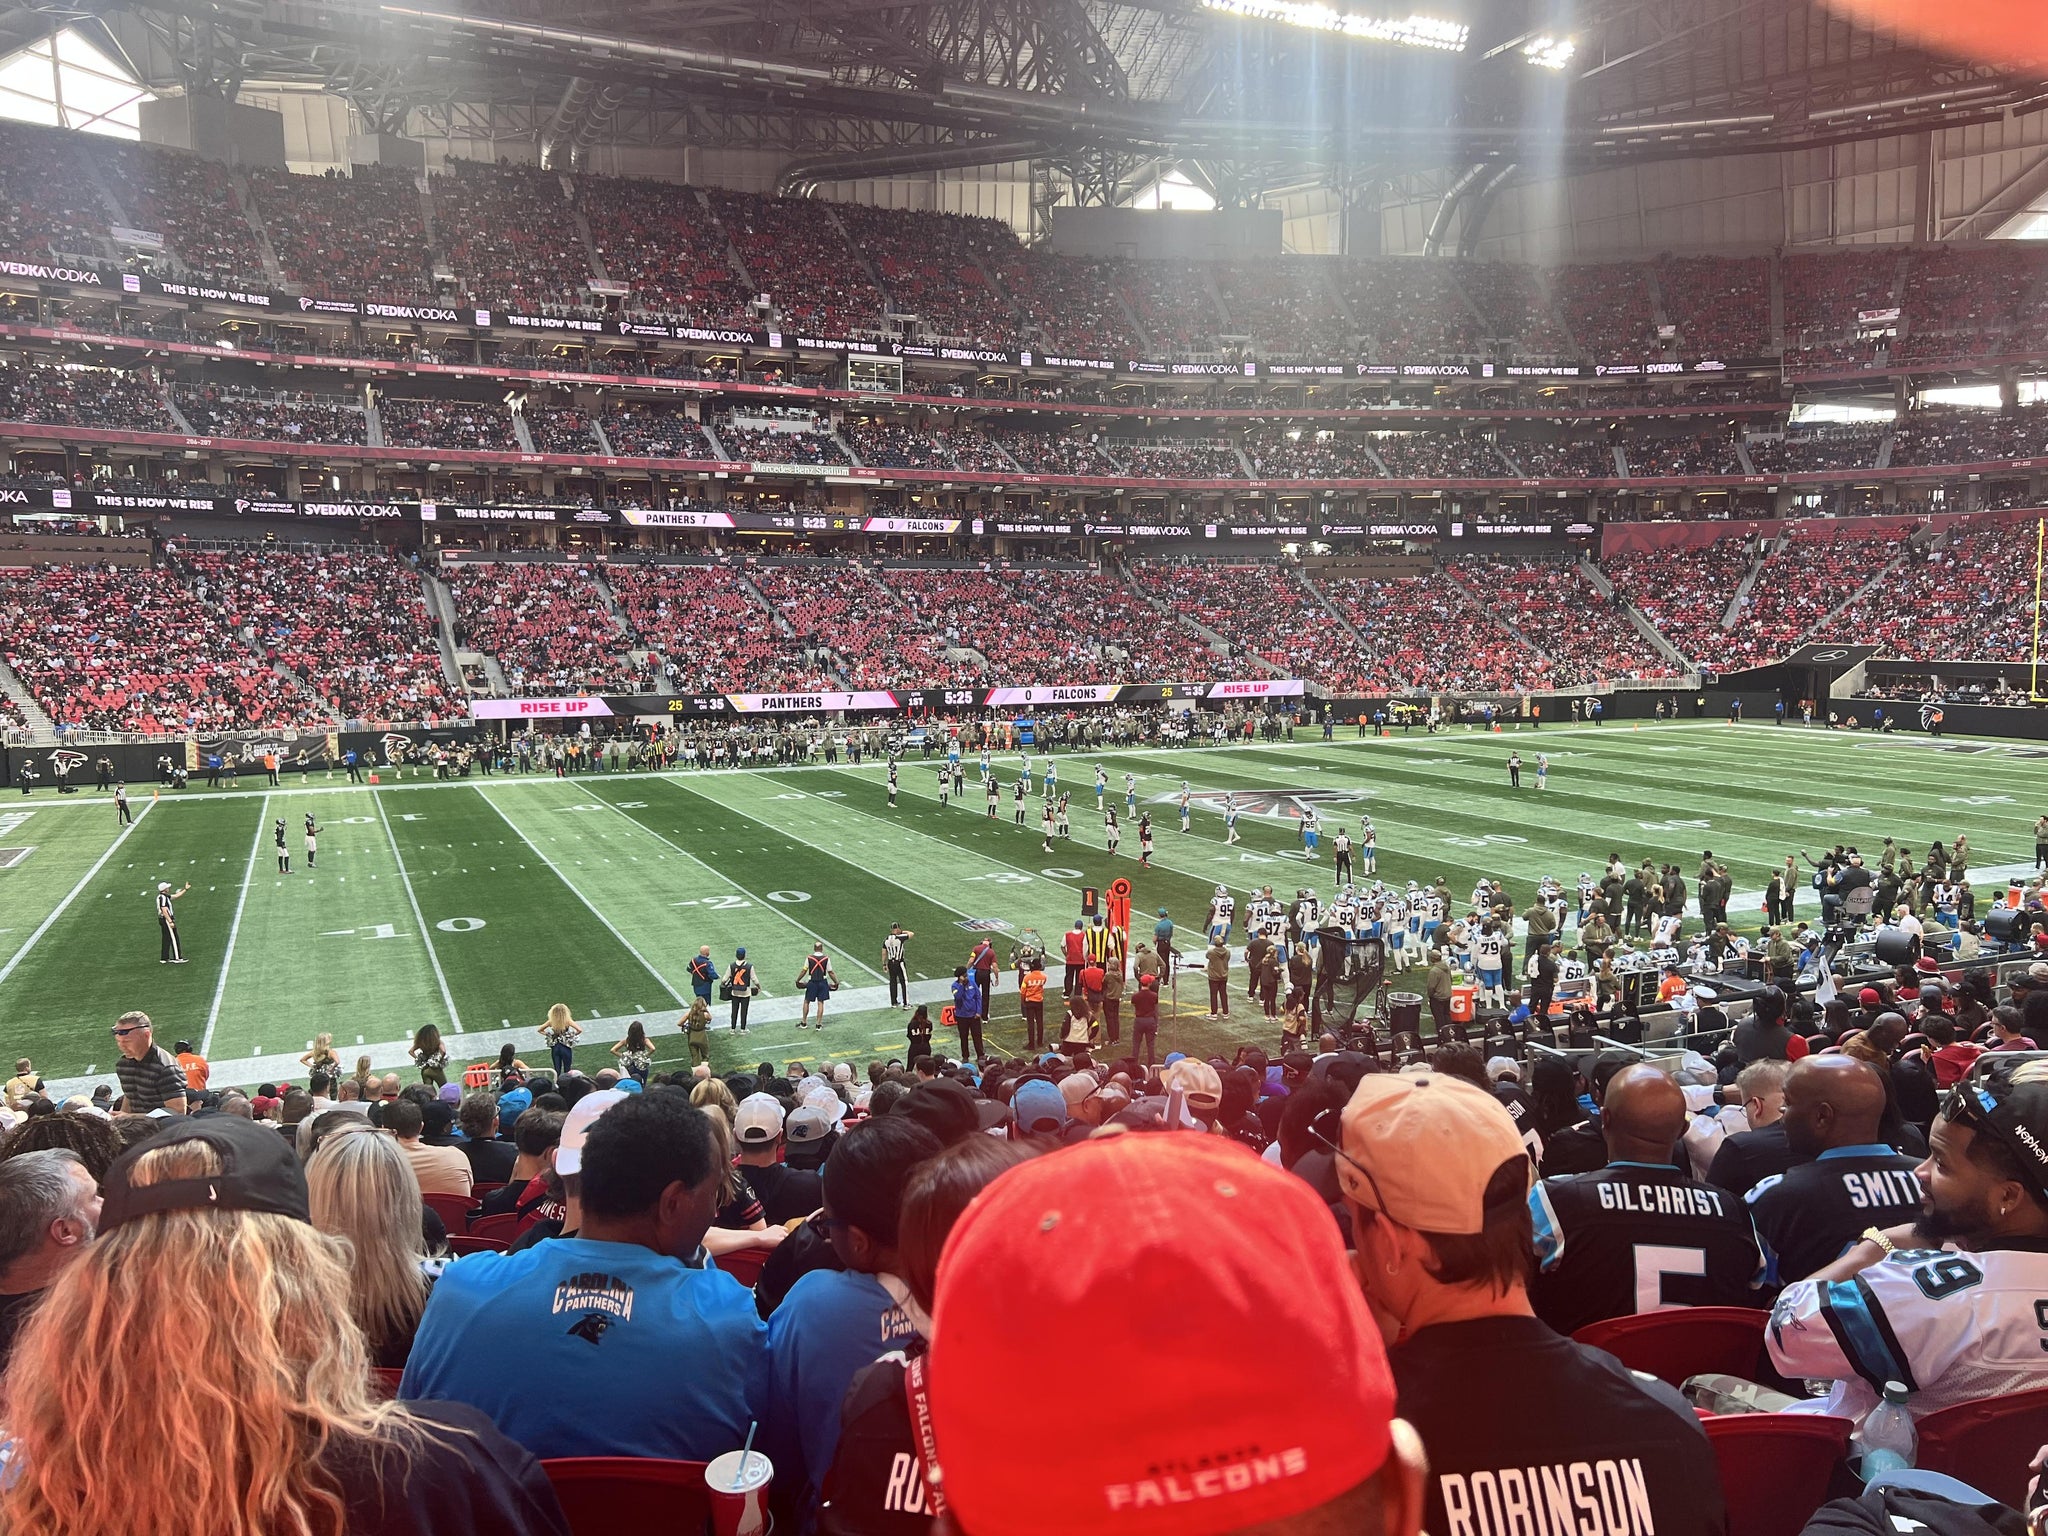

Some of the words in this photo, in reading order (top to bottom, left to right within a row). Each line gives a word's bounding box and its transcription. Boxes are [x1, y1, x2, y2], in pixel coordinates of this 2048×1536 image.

[161, 283, 187, 295] THIS
[188, 286, 199, 296] IS
[200, 288, 227, 300] HOW
[228, 291, 247, 303] WE
[247, 294, 270, 306] RISE
[507, 315, 530, 326] THIS
[530, 317, 540, 326] IS
[540, 318, 565, 328] HOW
[565, 320, 581, 330] WE
[582, 321, 603, 331] RISE
[796, 338, 815, 347] THIS
[816, 339, 824, 348] IS
[825, 340, 846, 349] HOW
[846, 342, 860, 351] WE
[860, 343, 878, 352] RISE
[1044, 357, 1061, 365] THIS
[1061, 358, 1068, 366] IS
[1069, 359, 1087, 367] HOW
[1087, 360, 1099, 368] WE
[1099, 361, 1114, 369] RISE
[1646, 363, 1683, 374] SVEDKA
[1286, 366, 1294, 374] IS
[1295, 366, 1314, 374] HOW
[1314, 366, 1326, 374] WE
[1327, 366, 1343, 374] RISE
[1506, 367, 1523, 375] THIS
[1523, 367, 1531, 375] IS
[1531, 367, 1550, 375] HOW
[1550, 367, 1563, 375] WE
[1563, 367, 1579, 375] RISE
[751, 463, 814, 475] Mercedes-Benz
[815, 466, 849, 477] Stadium
[94, 495, 122, 506] THIS
[124, 497, 136, 507] IS
[137, 497, 167, 507] HOW
[168, 498, 188, 509] WE
[189, 499, 214, 510] RISE
[454, 508, 478, 518] THIS
[479, 509, 490, 518] IS
[490, 509, 515, 520] HOW
[514, 510, 533, 520] WE
[534, 510, 556, 520] RISE
[646, 514, 696, 525] PANTHERS
[702, 515, 708, 525] 7
[783, 517, 795, 527] 35
[802, 517, 827, 529] 5:25
[833, 519, 844, 529] 25
[848, 522, 861, 530] 1ST
[888, 519, 894, 531] 0
[907, 519, 945, 532] FALCONS
[997, 524, 1014, 532] THIS
[1015, 524, 1022, 532] IS
[1042, 525, 1055, 533] WE
[1055, 525, 1071, 533] RISE
[1230, 527, 1248, 535] THIS
[1249, 527, 1257, 535] IS
[1257, 527, 1277, 535] HOW
[1277, 527, 1290, 535] WE
[1476, 525, 1494, 533] THIS
[1494, 525, 1502, 533] IS
[1502, 525, 1522, 533] HOW
[1522, 525, 1535, 533] WE
[1535, 525, 1552, 533] RISE
[1025, 689, 1032, 701] 0
[1052, 688, 1097, 701] FALCONS
[1161, 687, 1173, 697] 25
[1192, 685, 1204, 697] 35
[1223, 684, 1252, 694] RISE
[1254, 683, 1269, 693] UP
[693, 698, 707, 706] BALL
[709, 698, 724, 710] 35
[761, 696, 822, 710] PANTHERS
[846, 694, 854, 706] 7
[908, 697, 924, 707] 1ST
[944, 691, 973, 705] 5:25
[520, 703, 561, 714] RISE
[565, 701, 589, 713] UP
[668, 700, 683, 711] 25
[1086, 890, 1093, 907] 1
[1220, 904, 1232, 917] 95
[1310, 907, 1318, 920] 8
[1360, 906, 1374, 919] 98
[1432, 904, 1438, 917] 2
[1340, 912, 1353, 926] 93
[1265, 921, 1280, 936] 97
[1659, 920, 1668, 932] 9
[1480, 942, 1499, 955] 79
[733, 968, 746, 986] K
[1566, 966, 1583, 979] 68
[2014, 1124, 2048, 1166] Nephew
[1597, 1182, 1725, 1218] GILCHRIST
[552, 1272, 634, 1323] CAROLINA
[564, 1295, 621, 1317] PANTHERS
[914, 1393, 939, 1474] FALCONS
[1103, 1446, 1308, 1512] FALCONS
[1440, 1457, 1655, 1536] ROBINSON
